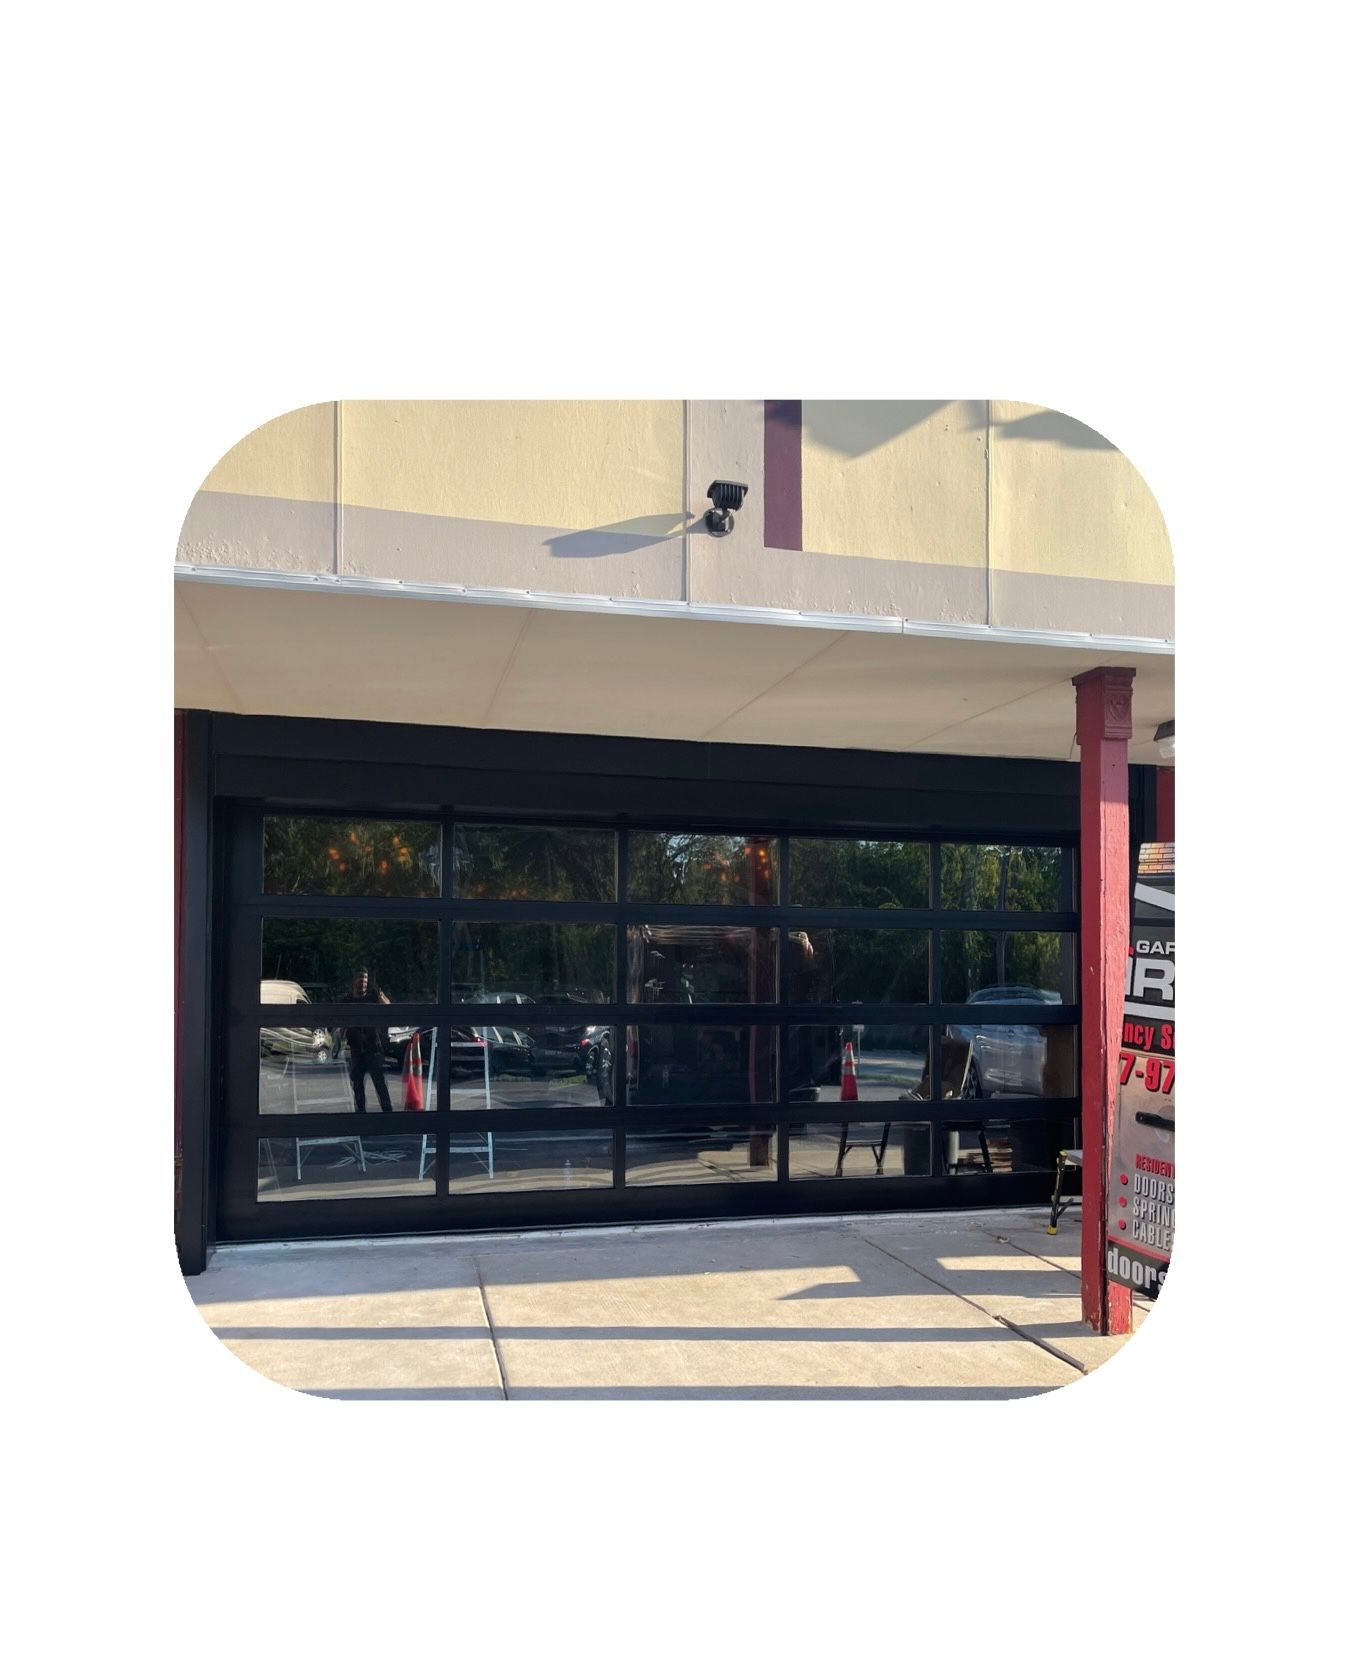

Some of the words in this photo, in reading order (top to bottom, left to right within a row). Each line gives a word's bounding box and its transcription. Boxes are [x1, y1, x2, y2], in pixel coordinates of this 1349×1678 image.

[1160, 1023, 1175, 1051] S
[1134, 1174, 1175, 1205] DOORS
[1132, 1219, 1174, 1252] CABLE
